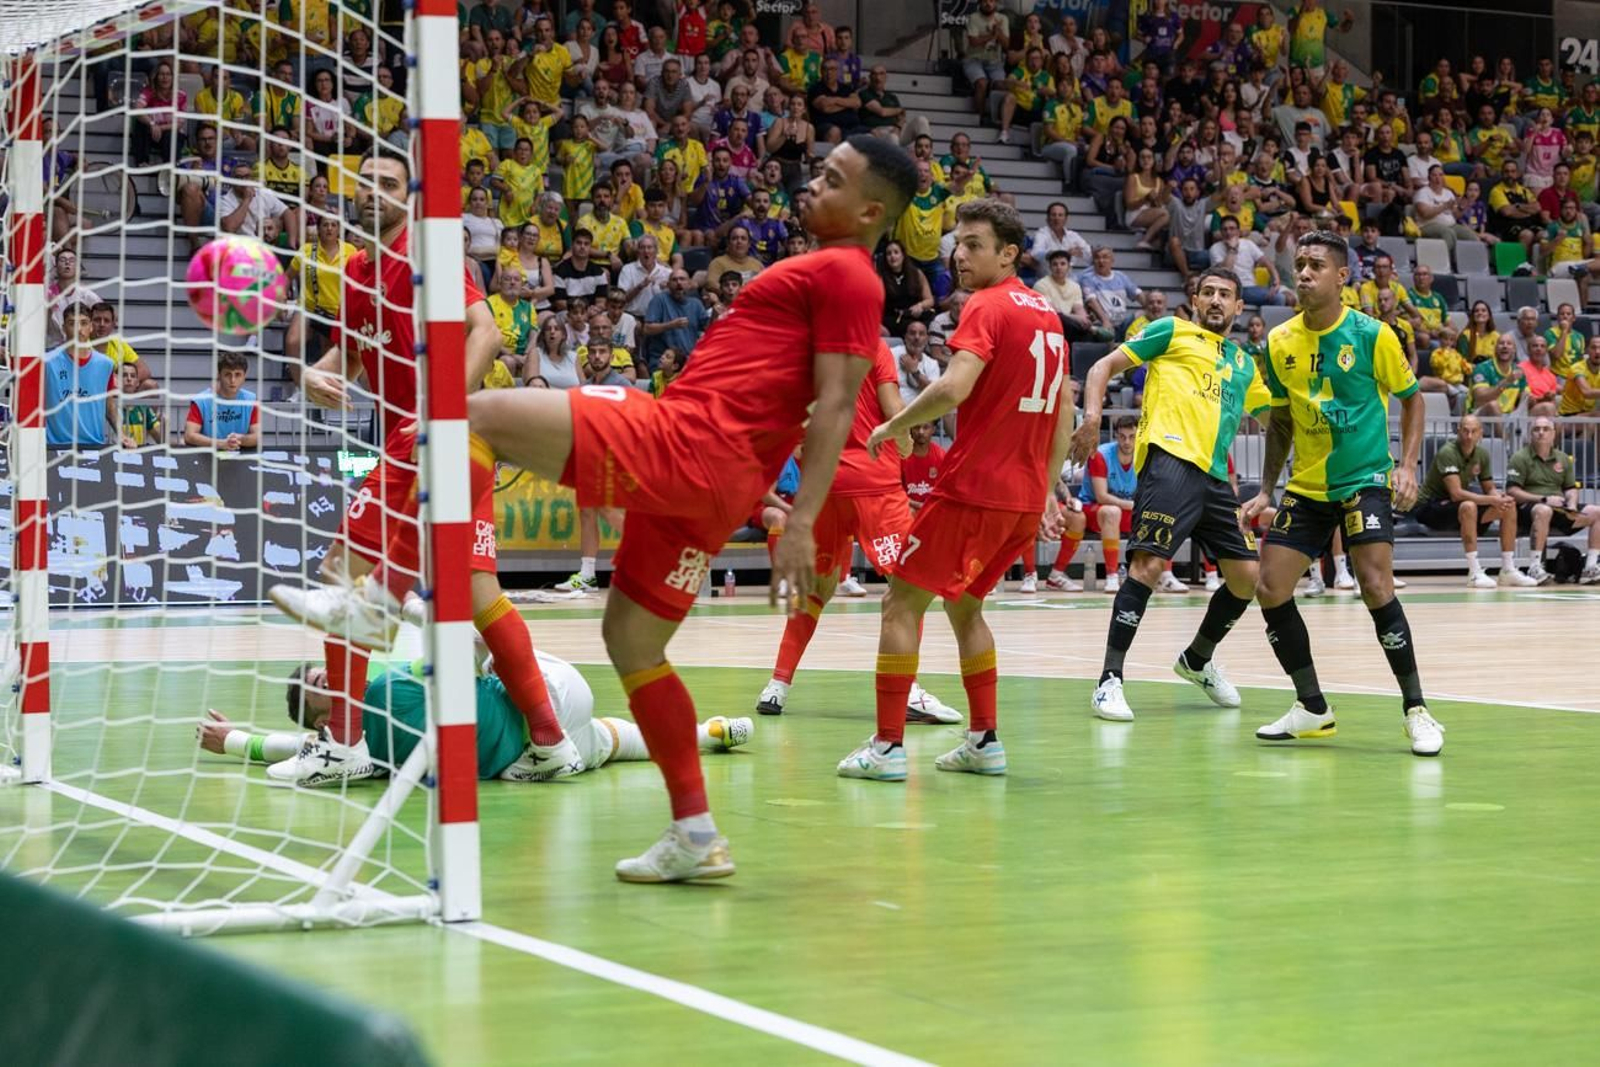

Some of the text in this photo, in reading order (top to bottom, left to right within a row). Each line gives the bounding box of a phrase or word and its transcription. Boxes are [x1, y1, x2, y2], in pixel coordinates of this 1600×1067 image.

[756, 0, 797, 14] Sector
[1561, 37, 1599, 75] 24
[1018, 329, 1064, 414] 17
[1310, 353, 1325, 373] 12
[495, 499, 574, 540] IVO
